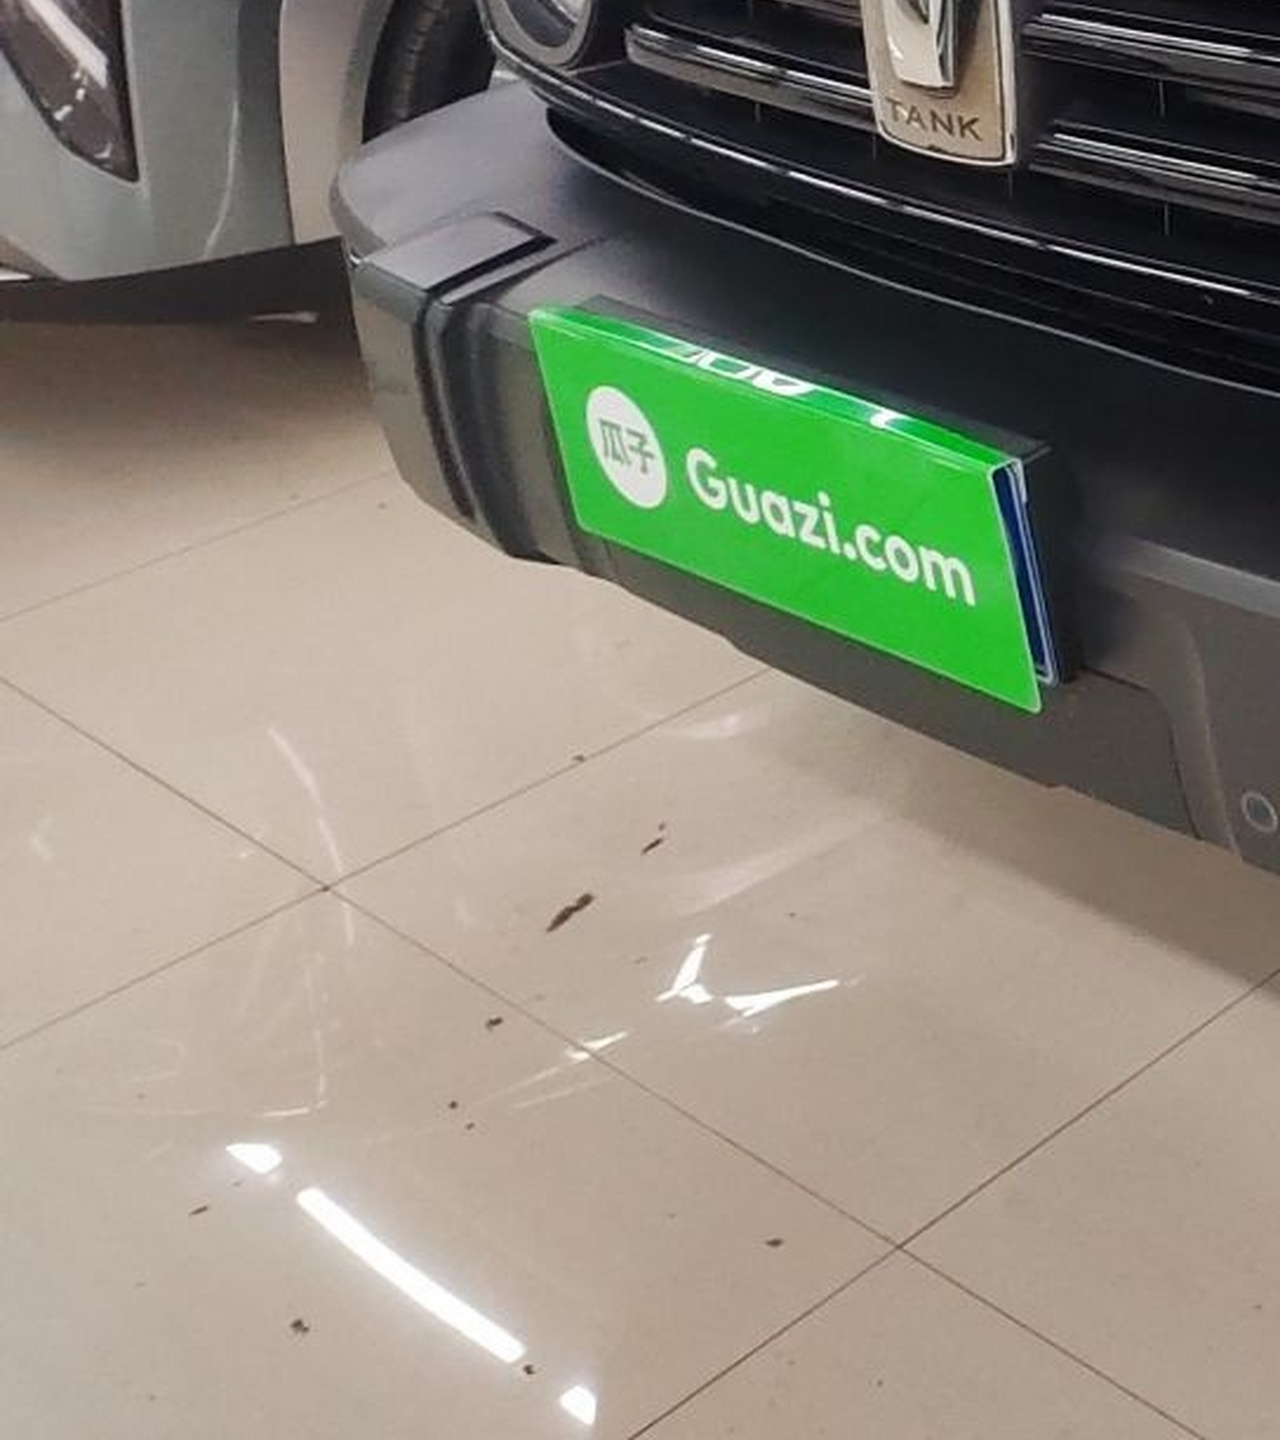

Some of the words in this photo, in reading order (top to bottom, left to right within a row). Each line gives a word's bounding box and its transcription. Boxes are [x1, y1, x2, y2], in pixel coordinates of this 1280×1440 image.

[885, 96, 983, 142] TANK
[598, 418, 656, 475] 瓜子
[685, 447, 977, 606] Guazi.com
